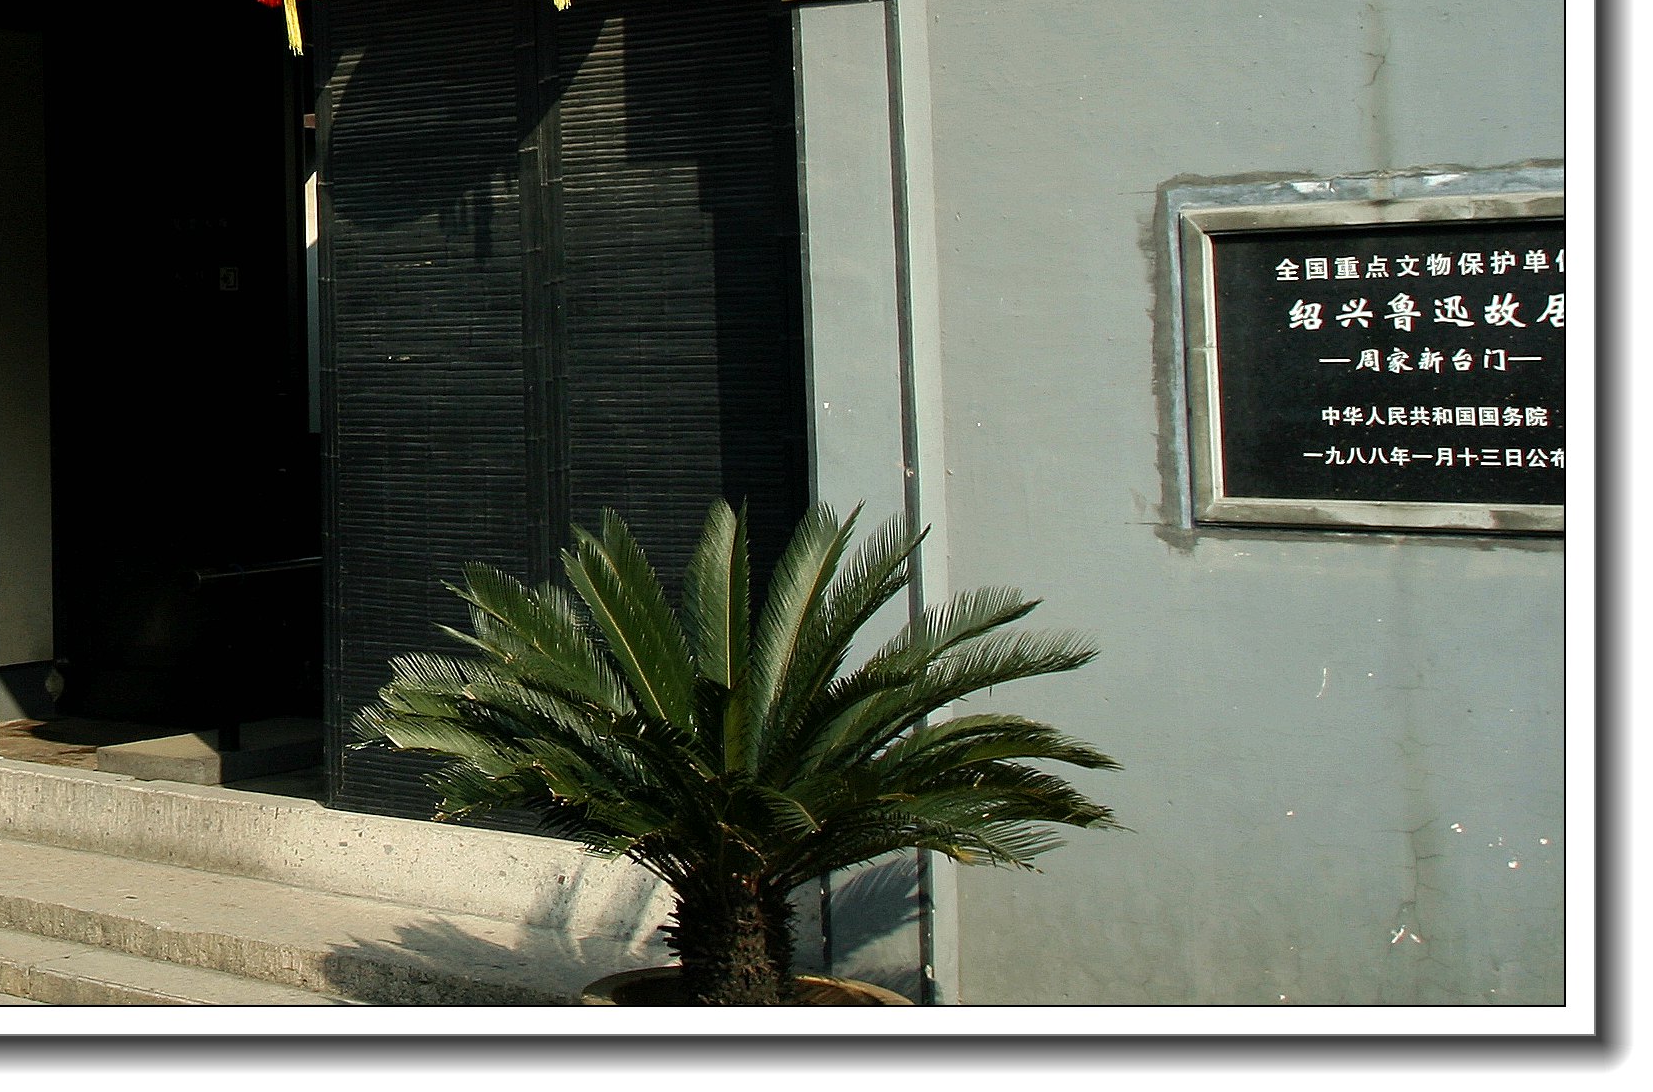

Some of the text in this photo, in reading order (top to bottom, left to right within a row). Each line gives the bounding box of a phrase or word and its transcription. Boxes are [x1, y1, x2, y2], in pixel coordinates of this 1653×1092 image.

[1321, 406, 1548, 427] 中华人民共和国国务院
[1303, 446, 1565, 469] 一九八八年一月十三日公布
